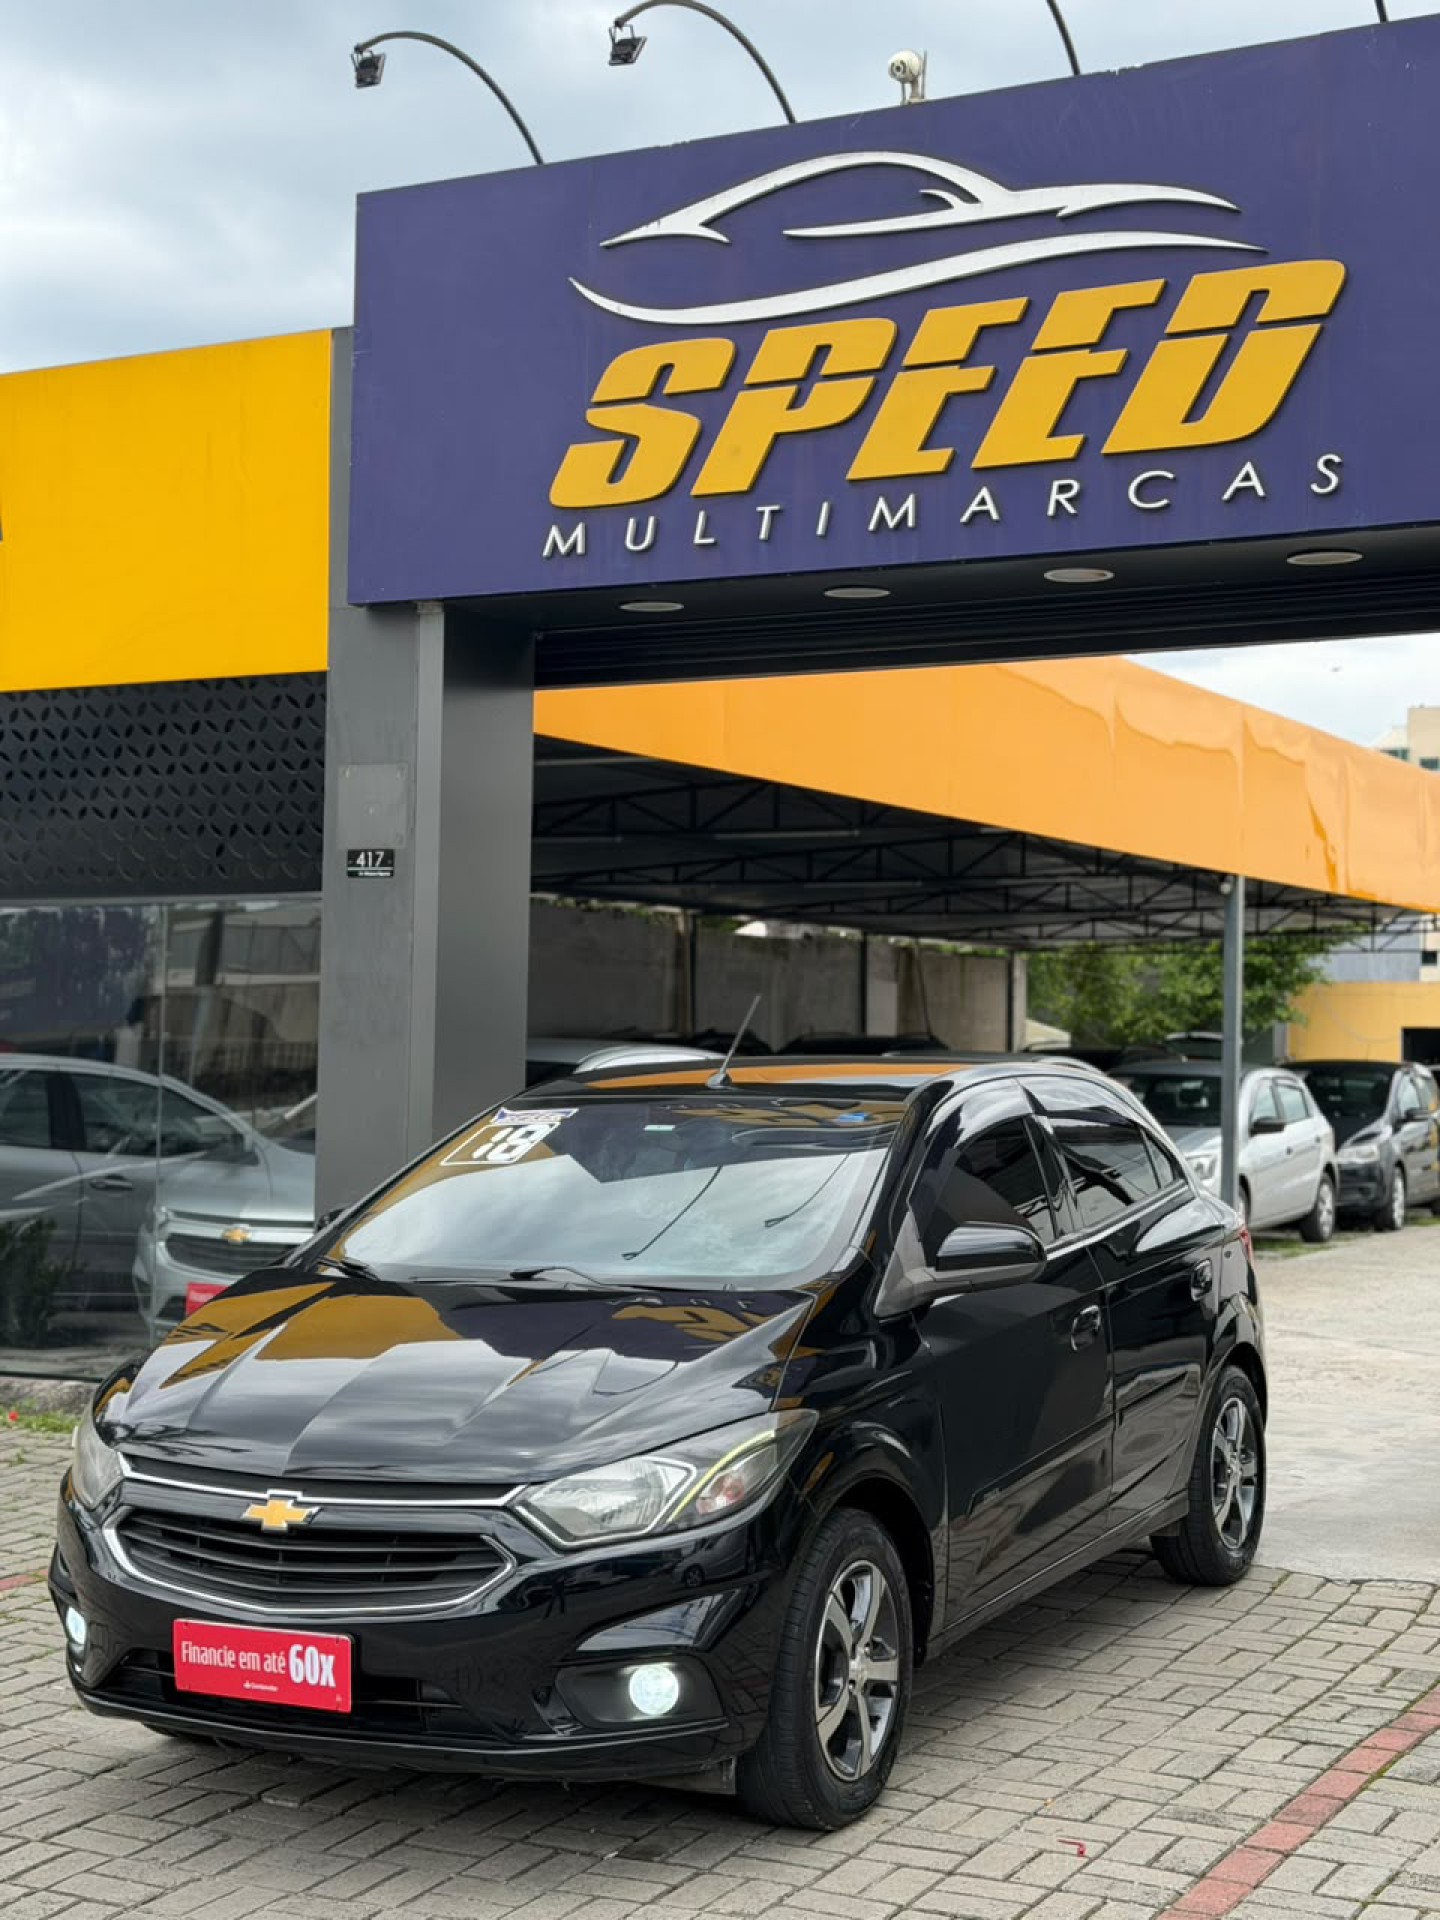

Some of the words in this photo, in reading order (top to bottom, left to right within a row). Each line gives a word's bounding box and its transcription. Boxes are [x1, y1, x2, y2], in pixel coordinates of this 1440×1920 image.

[549, 259, 1346, 509] SPEED
[542, 453, 1344, 558] MULTIMARCAS
[356, 851, 385, 868] 417
[472, 1125, 550, 1161] 18
[181, 1640, 235, 1668] Financie
[239, 1651, 261, 1671] em
[263, 1651, 286, 1674] até
[289, 1644, 336, 1688] 60x
